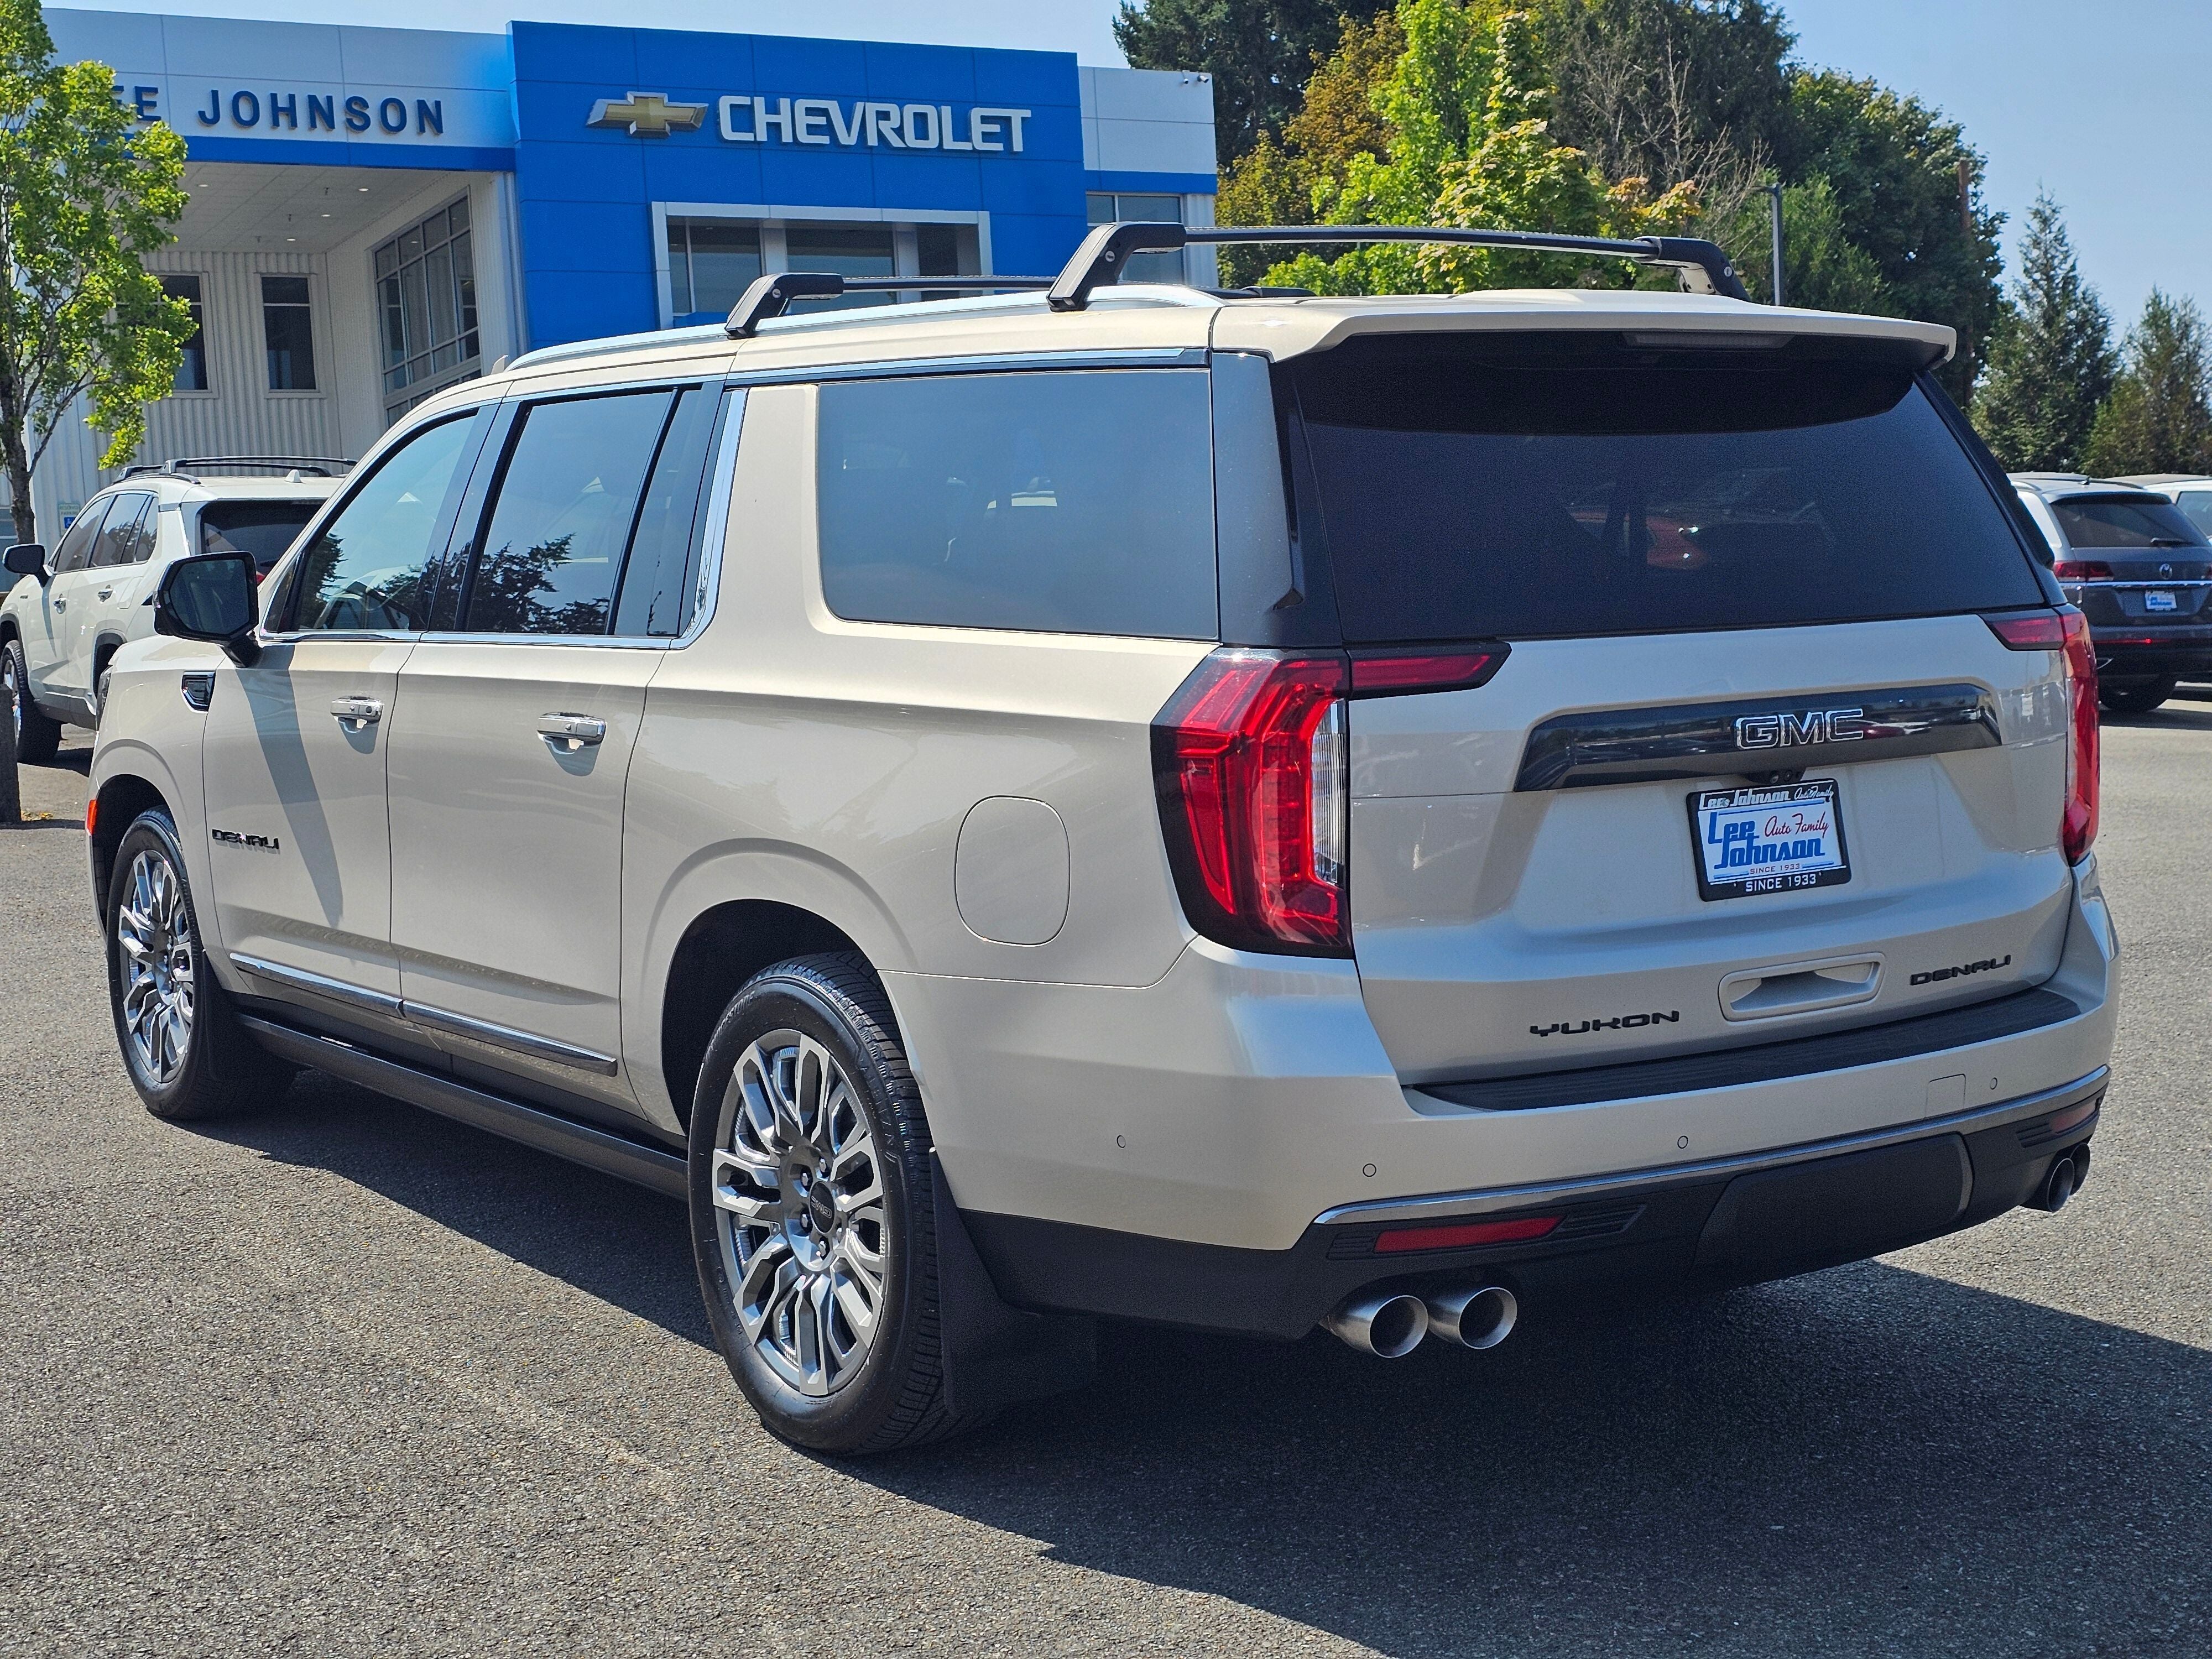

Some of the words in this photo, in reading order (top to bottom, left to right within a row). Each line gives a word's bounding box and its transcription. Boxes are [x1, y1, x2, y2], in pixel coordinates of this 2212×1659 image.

[198, 90, 444, 135] JOHNSON
[718, 96, 1032, 153] CHEVROLET
[1735, 708, 1864, 749] GMC
[1730, 789, 1791, 807] Johnson
[211, 829, 279, 849] DENALI
[1708, 812, 1759, 844] Lee
[1764, 815, 1792, 837] Auto
[1792, 811, 1829, 838] Family
[1714, 838, 1825, 870] Johnson
[1745, 879, 1782, 893] SINCE
[1787, 874, 1817, 887] 1933
[1750, 865, 1776, 875] SINCE
[1780, 863, 1801, 872] 1933
[1911, 954, 2012, 985] DENALI
[1530, 1010, 1680, 1037] YUKON
[811, 1195, 833, 1219] GMC
